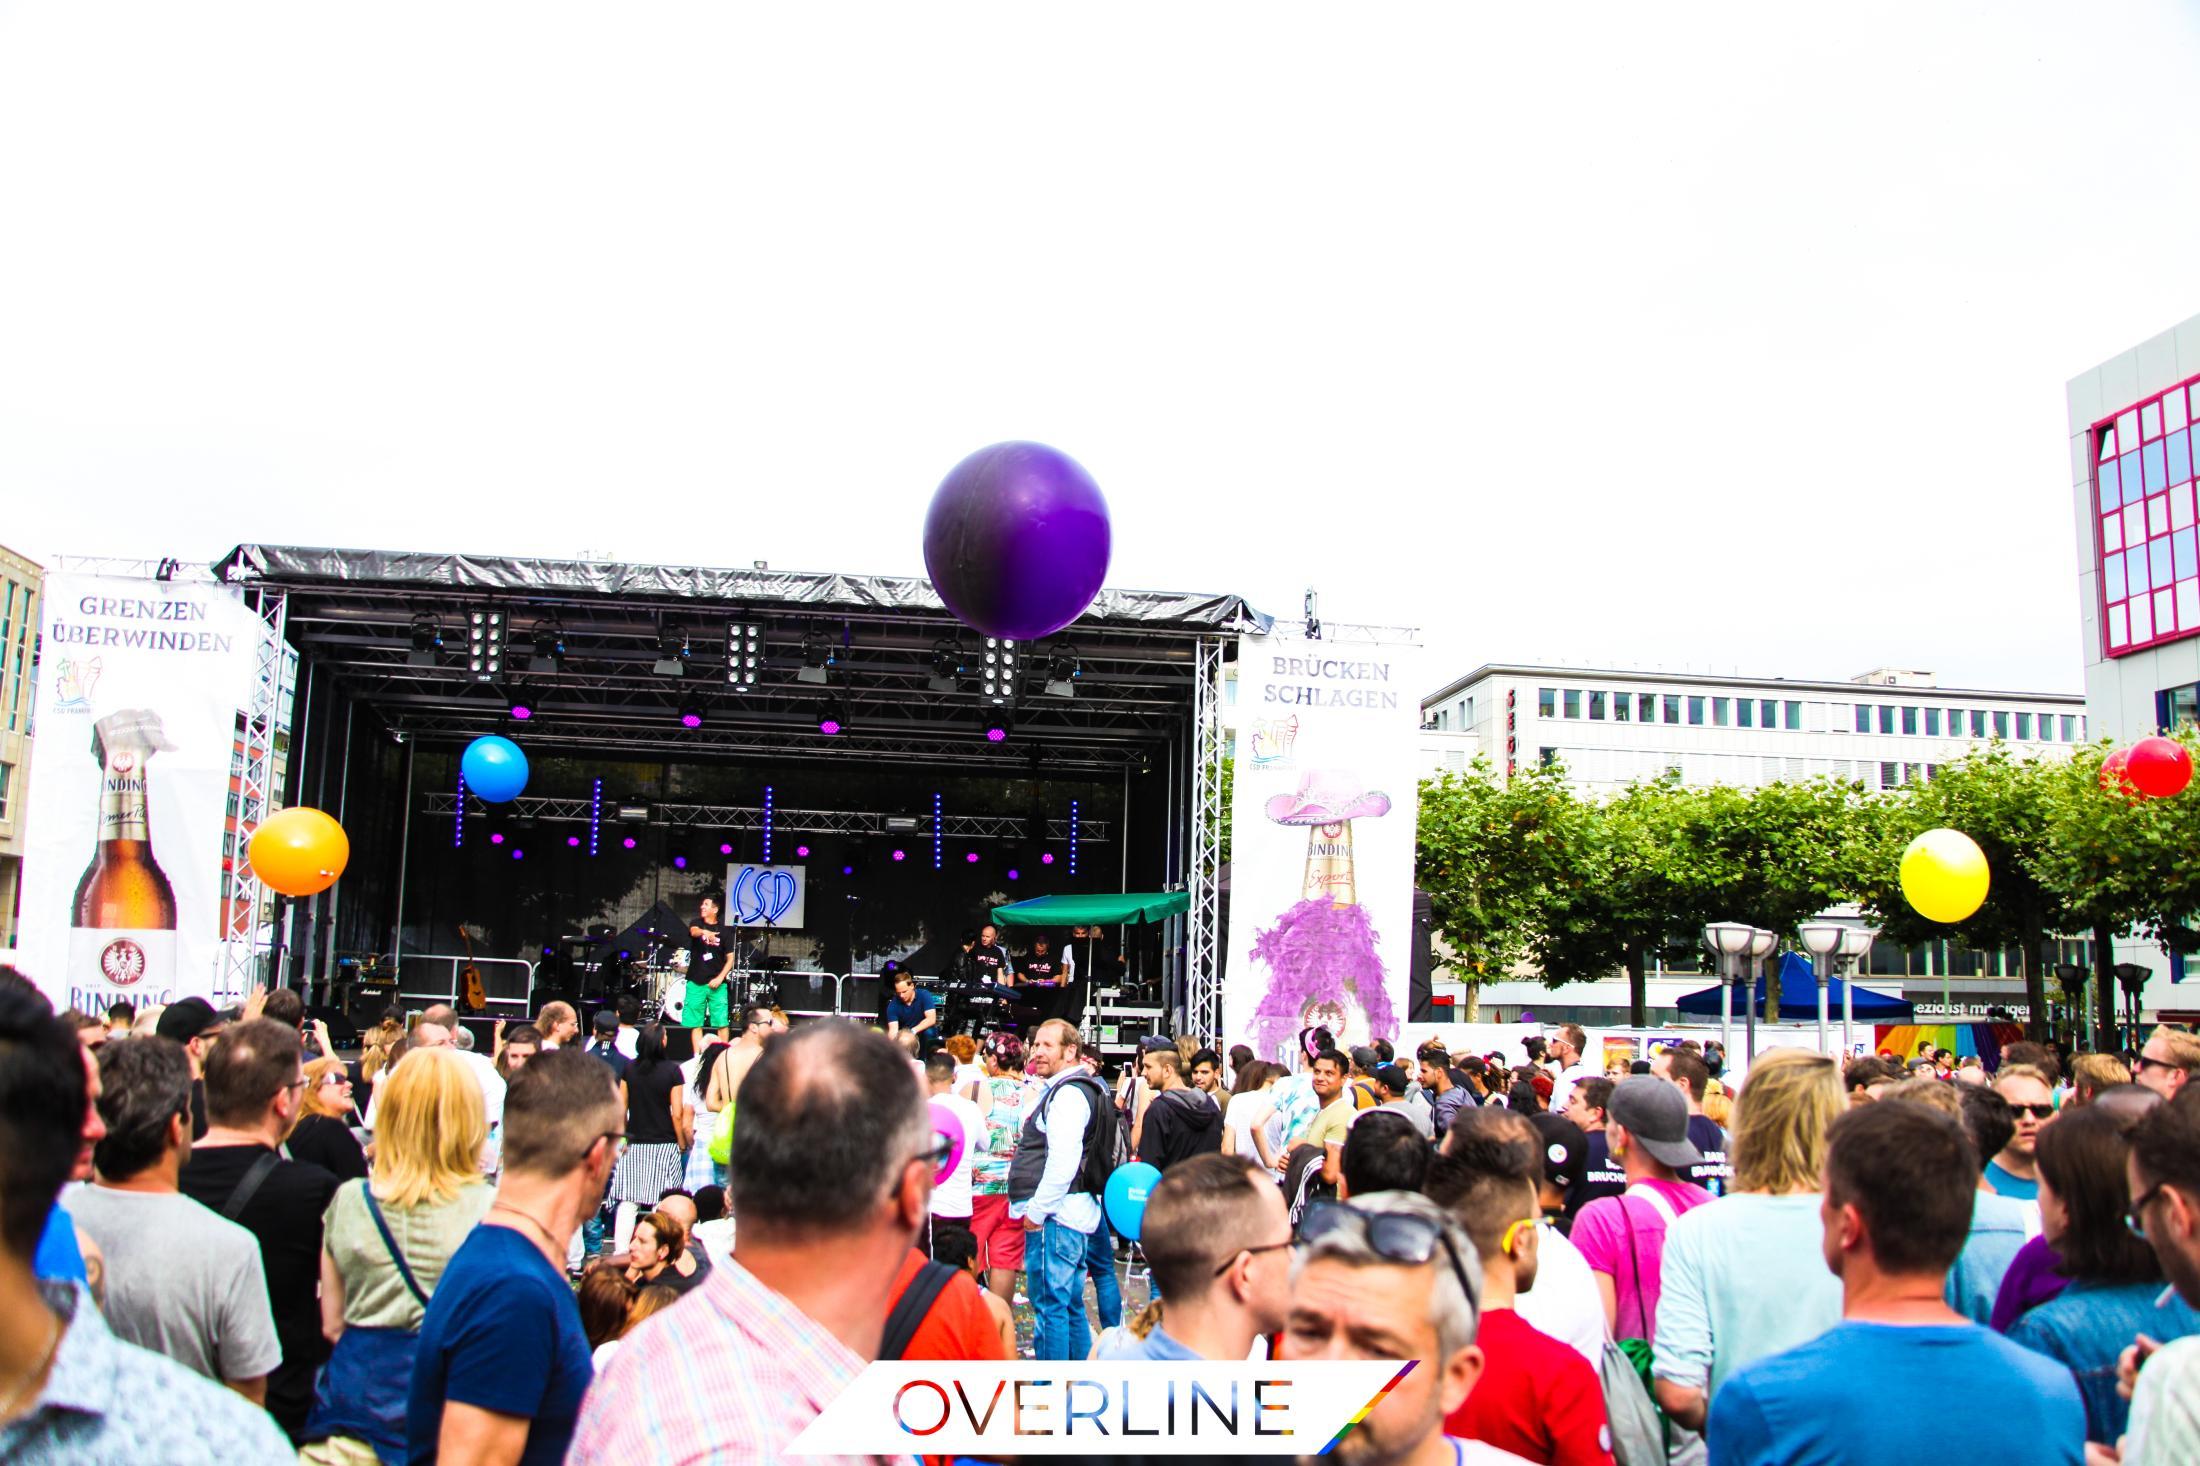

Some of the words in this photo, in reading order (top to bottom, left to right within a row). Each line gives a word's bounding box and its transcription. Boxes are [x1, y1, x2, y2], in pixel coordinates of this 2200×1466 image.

[79, 596, 207, 621] GRENZEN
[52, 617, 232, 653] ÜBERWINDEN
[1272, 653, 1389, 682] BRÜCKEN
[1264, 684, 1398, 710] SCHLAGEN
[734, 866, 796, 925] CSD
[1913, 1000, 1965, 1014] eziaist
